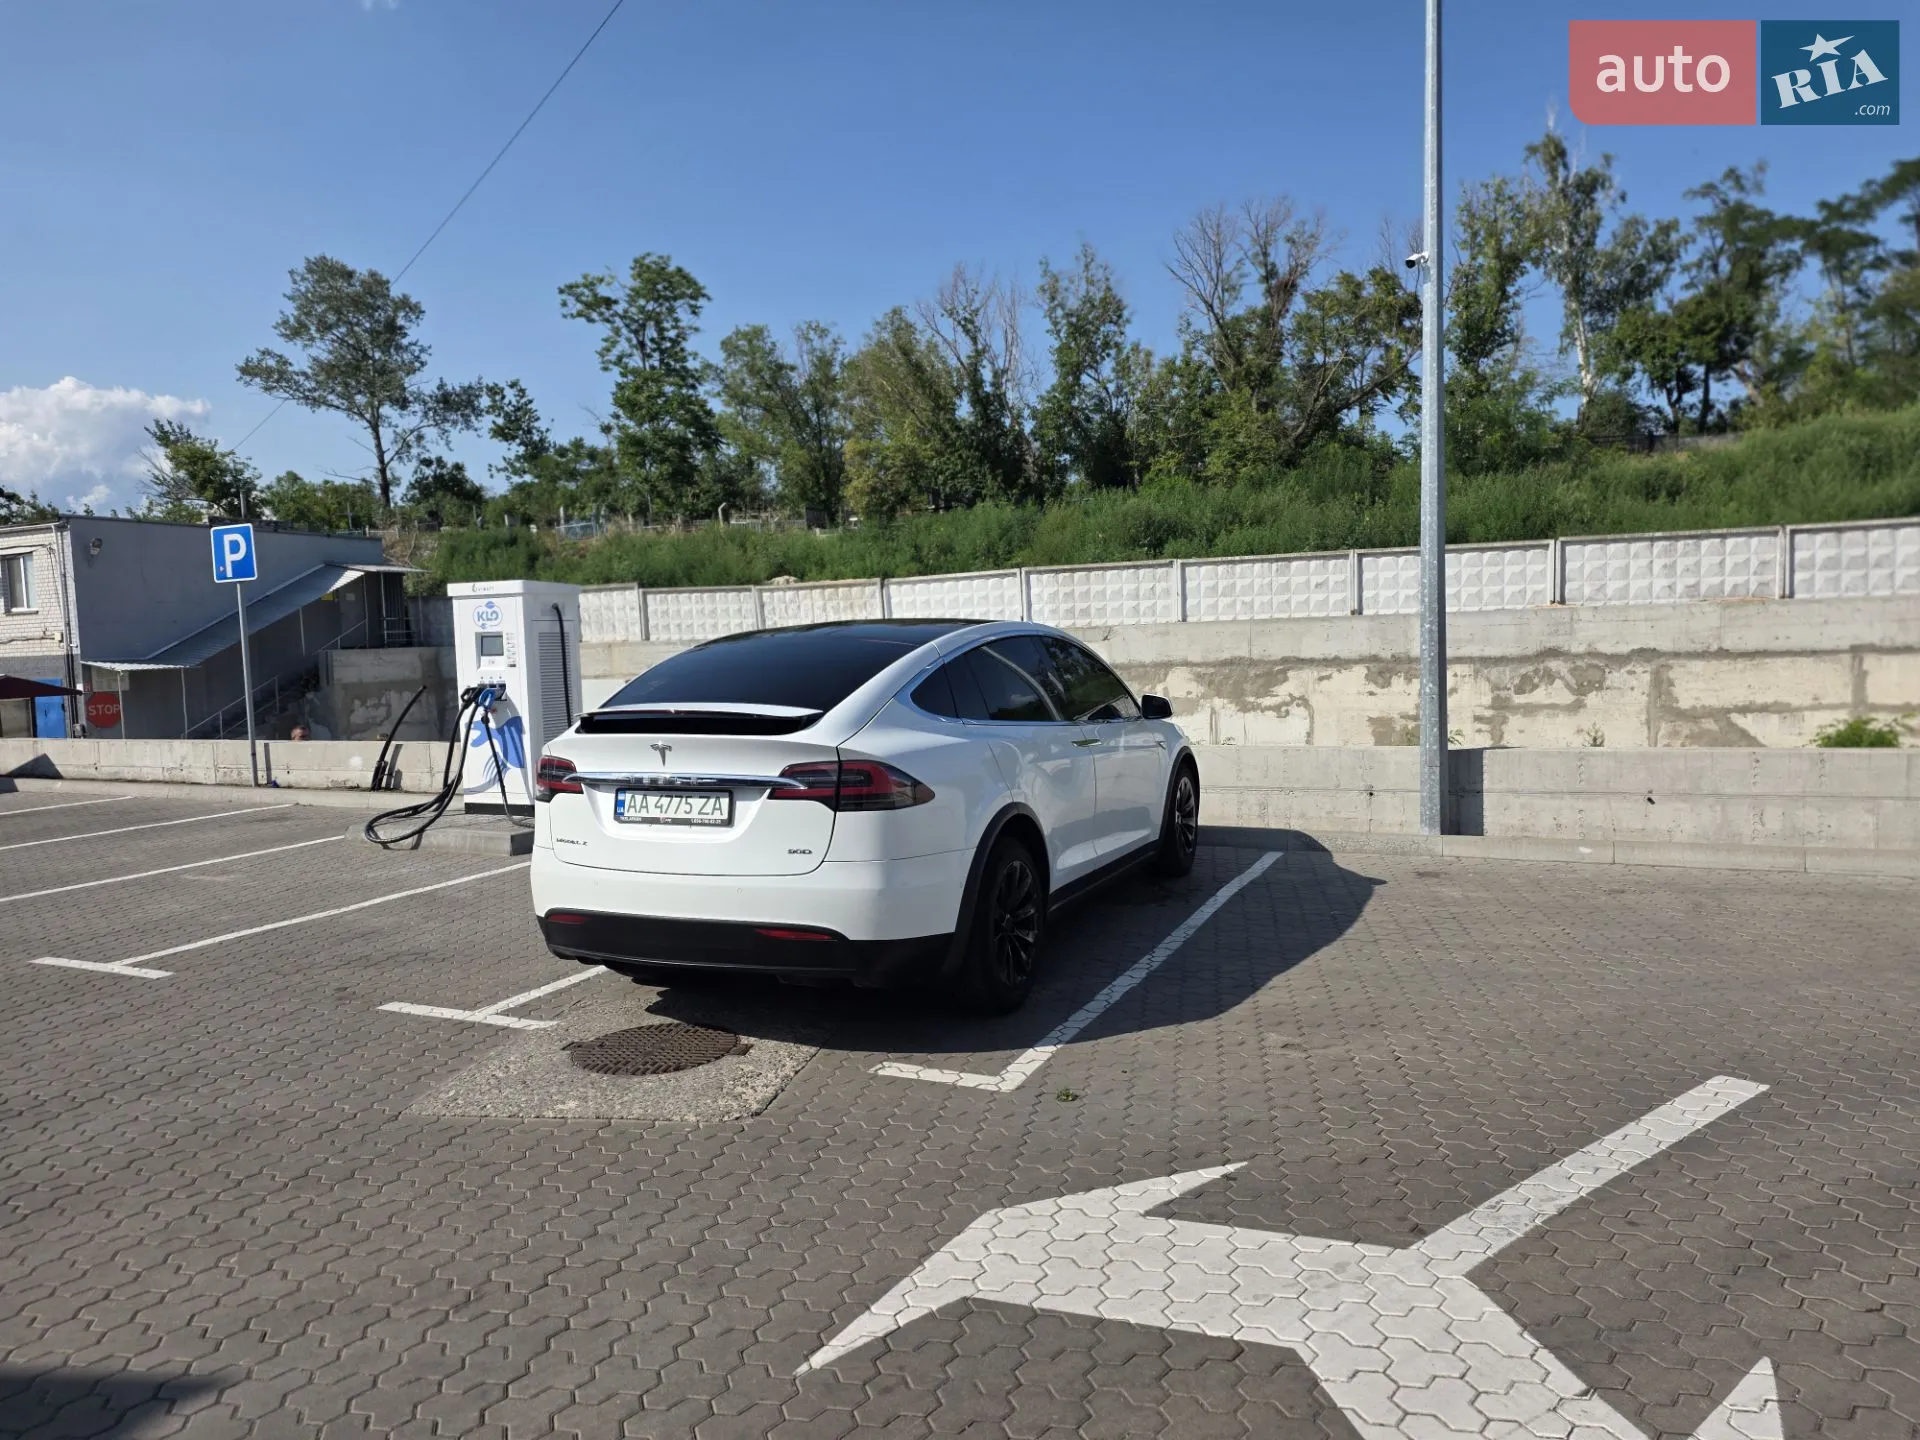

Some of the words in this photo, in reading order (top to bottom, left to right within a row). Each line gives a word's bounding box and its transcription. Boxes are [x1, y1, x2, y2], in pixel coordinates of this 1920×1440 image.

[223, 533, 247, 578] P
[88, 703, 121, 716] STOP
[626, 794, 650, 814] AA
[654, 795, 693, 815] 4775
[697, 795, 724, 816] ZA
